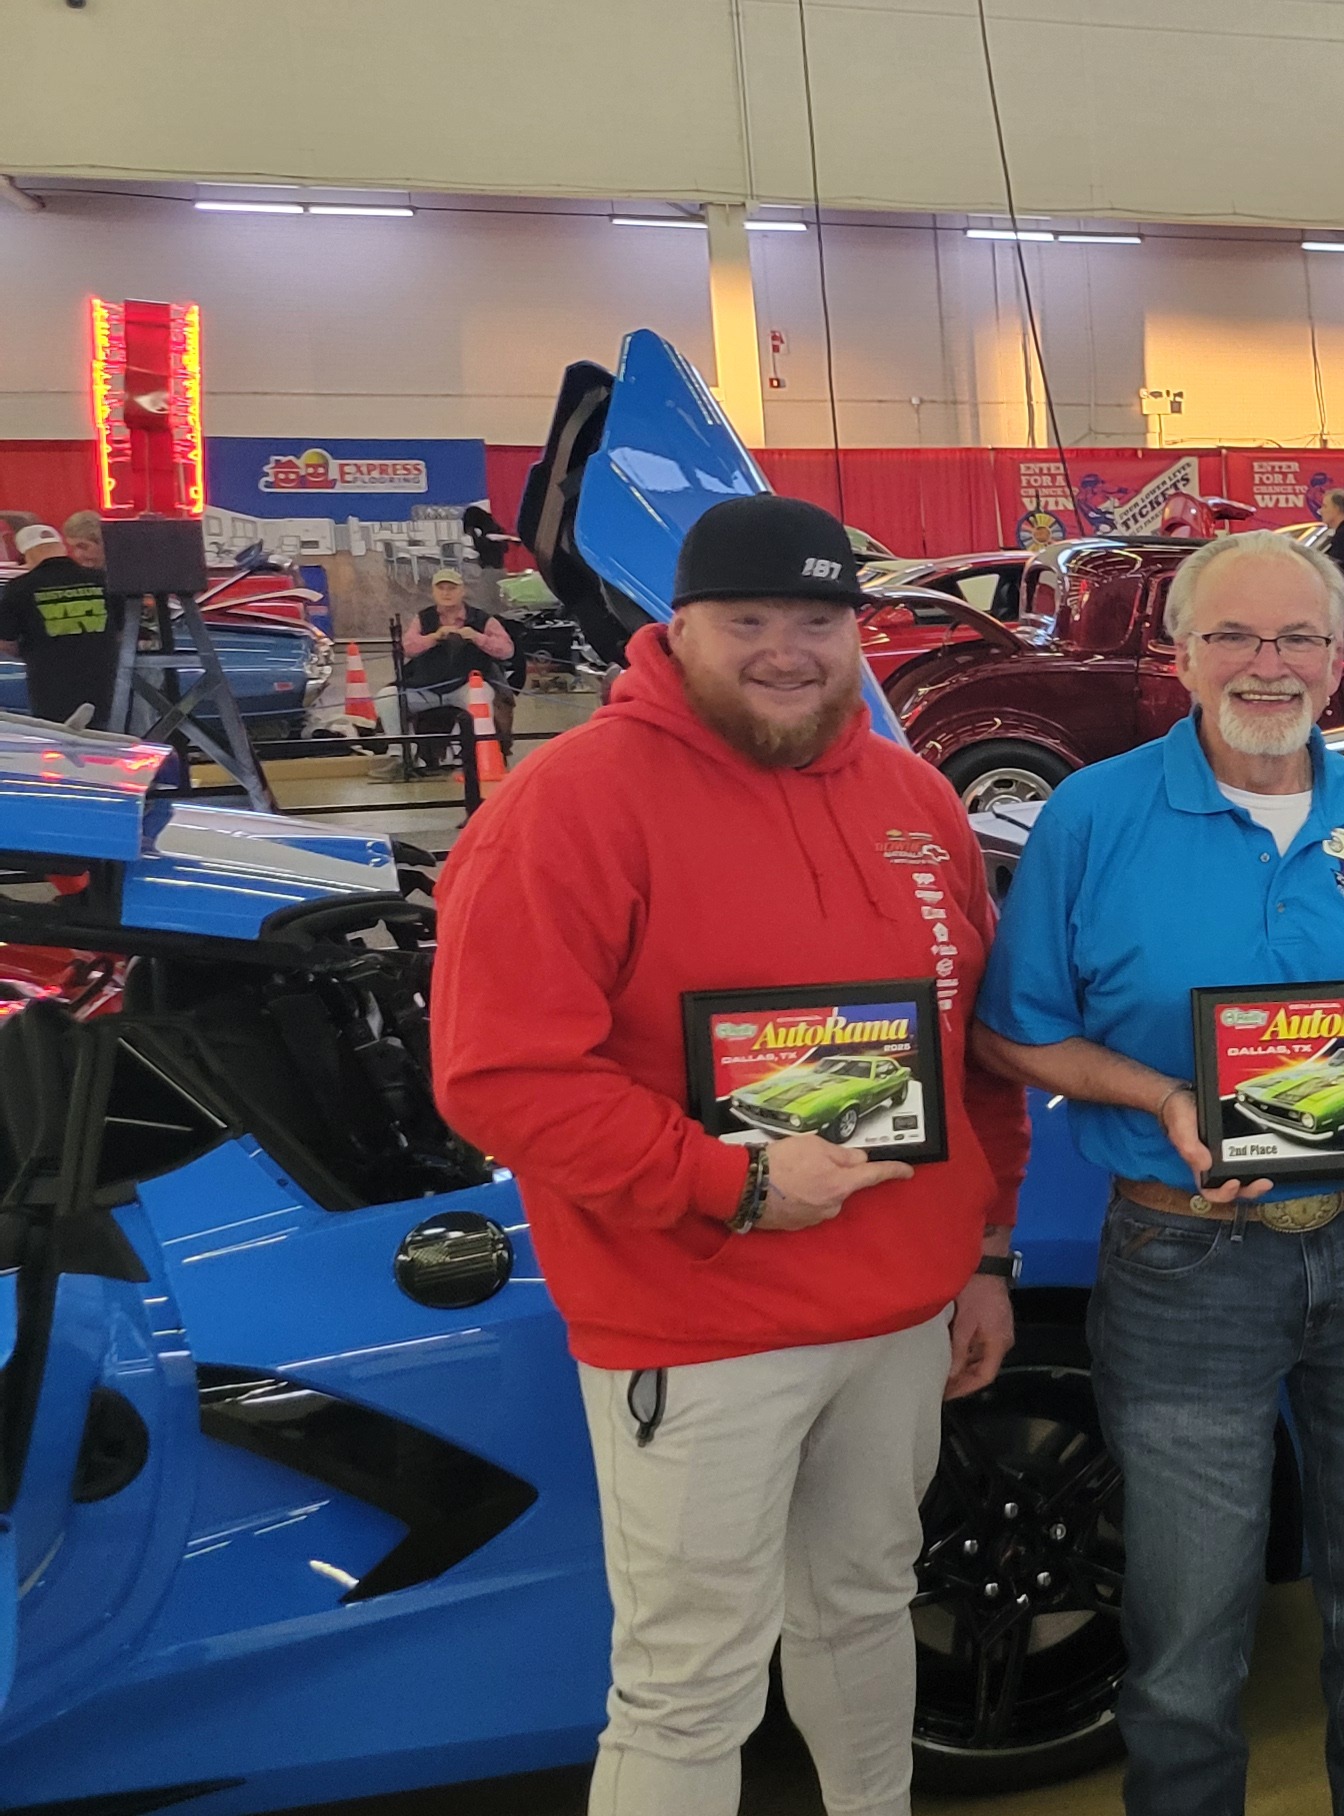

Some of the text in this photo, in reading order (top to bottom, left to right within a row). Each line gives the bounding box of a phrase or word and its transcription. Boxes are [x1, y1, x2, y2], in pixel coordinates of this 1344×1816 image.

[338, 463, 423, 484] EXPRESS
[1253, 462, 1300, 472] ENTER
[352, 476, 420, 484] FLOORING
[1021, 476, 1066, 486] FOR A
[1254, 474, 1296, 484] FOR A
[1253, 485, 1308, 493] CHANCE TO
[1022, 498, 1075, 511] WIN
[1254, 495, 1305, 508] WIN
[751, 1015, 910, 1050] AutoRama
[1227, 1043, 1313, 1056] DALLAS, TX
[720, 1052, 798, 1065] DALLAS, TX
[1228, 1143, 1278, 1157] 2nd Place
